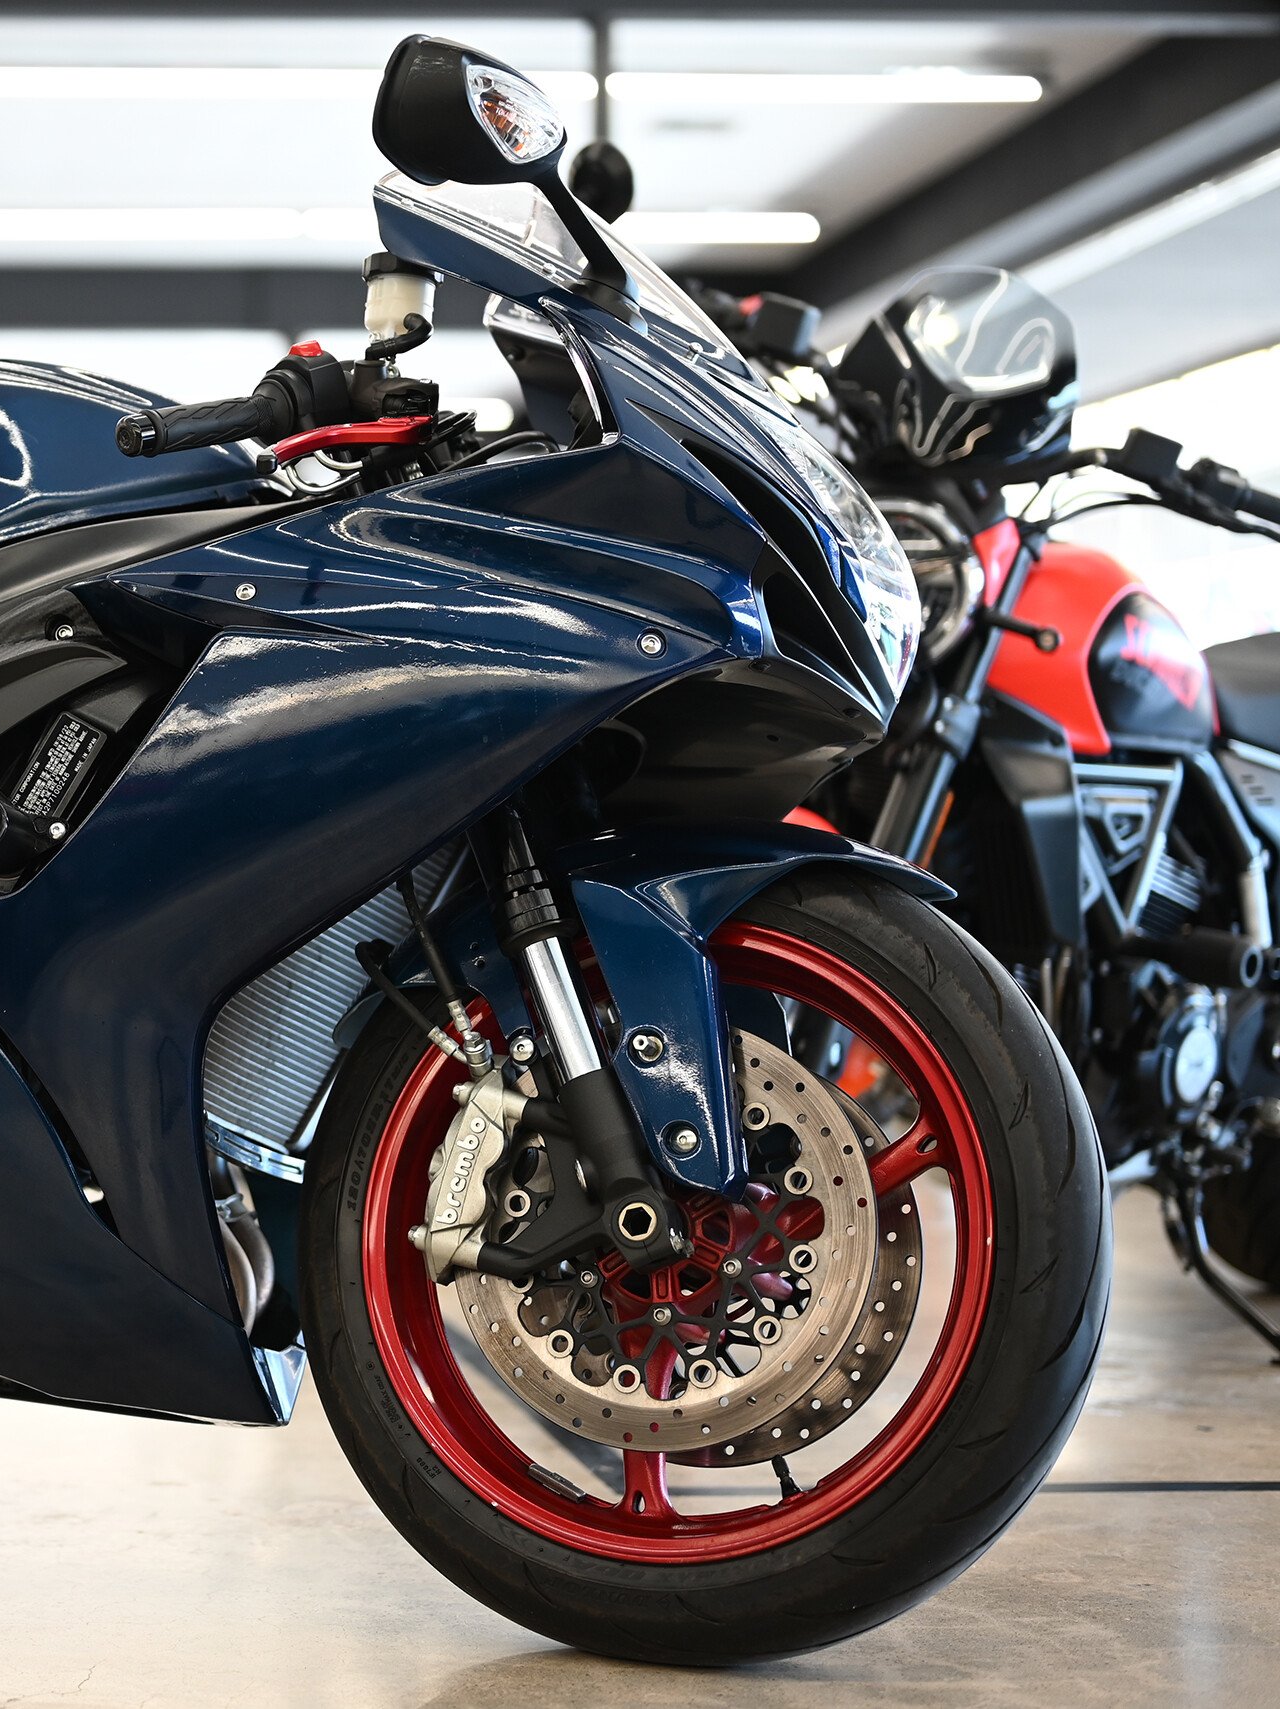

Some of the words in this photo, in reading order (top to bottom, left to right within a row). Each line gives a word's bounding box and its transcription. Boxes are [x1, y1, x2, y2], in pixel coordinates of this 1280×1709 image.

[73, 760, 83, 772] MADE
[86, 737, 97, 751] JAPAN
[18, 761, 40, 792] CORPORATION
[435, 1117, 486, 1224] brembo
